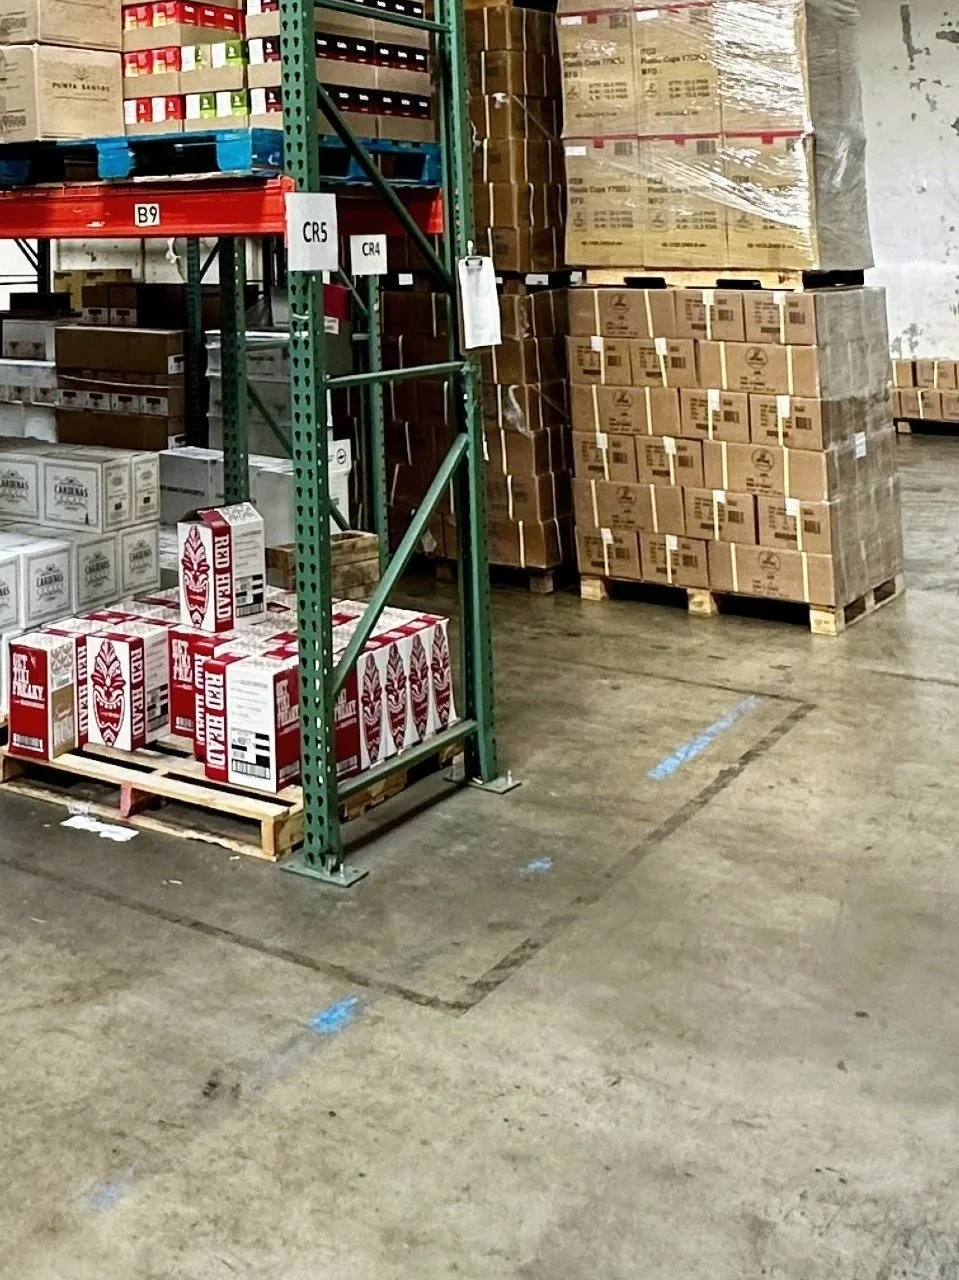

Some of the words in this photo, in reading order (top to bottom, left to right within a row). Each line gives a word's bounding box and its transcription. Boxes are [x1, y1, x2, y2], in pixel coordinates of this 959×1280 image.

[52, 81, 78, 91] PUNTA
[81, 83, 110, 93] SANTOS
[137, 206, 157, 223] B9
[302, 221, 328, 243] CR5
[362, 242, 380, 256] CR4
[54, 484, 89, 498] CARDENAS
[214, 535, 230, 570] RED
[216, 574, 231, 620] HEAD
[130, 647, 143, 684] RED
[205, 670, 225, 710] RED
[132, 685, 145, 737] HEAD
[207, 713, 226, 768] HEAD
